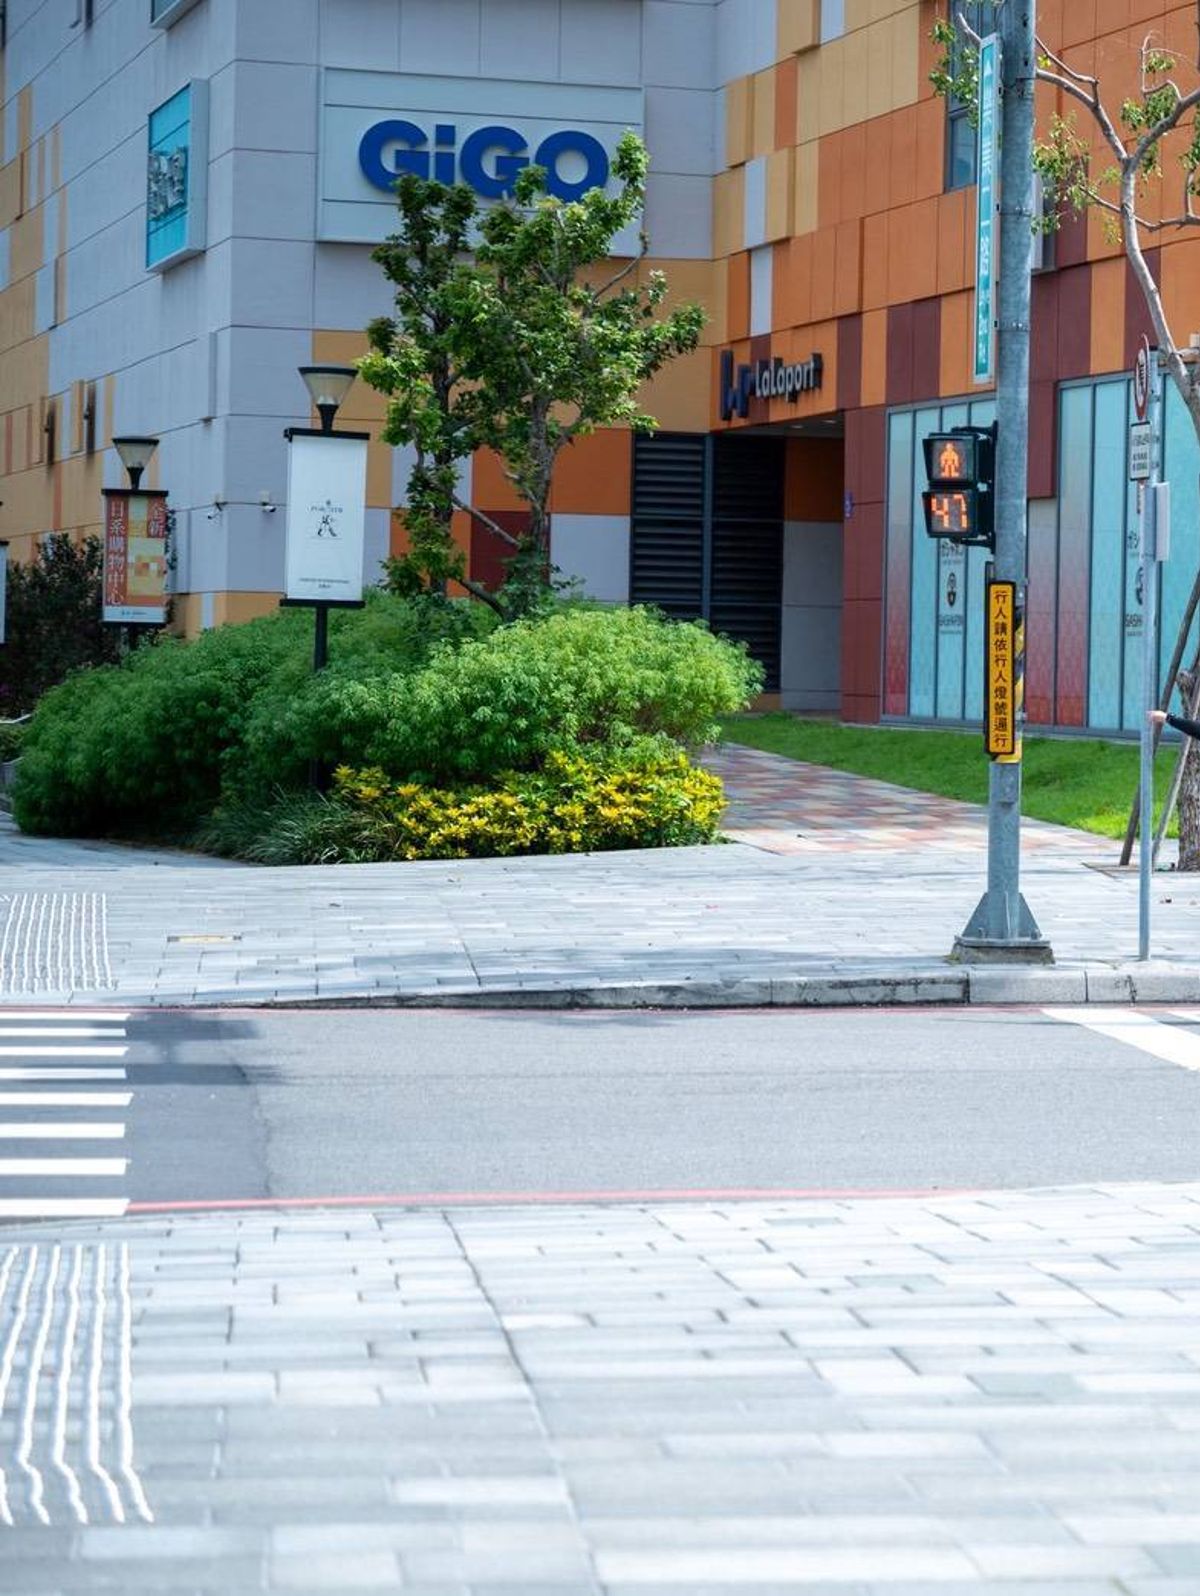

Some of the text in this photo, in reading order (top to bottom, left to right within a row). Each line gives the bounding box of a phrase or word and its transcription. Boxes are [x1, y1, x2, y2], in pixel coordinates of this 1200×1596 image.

[359, 119, 609, 203] GiGO
[931, 493, 968, 528] 47
[994, 590, 1008, 748] 行人請依行人燈號通行
